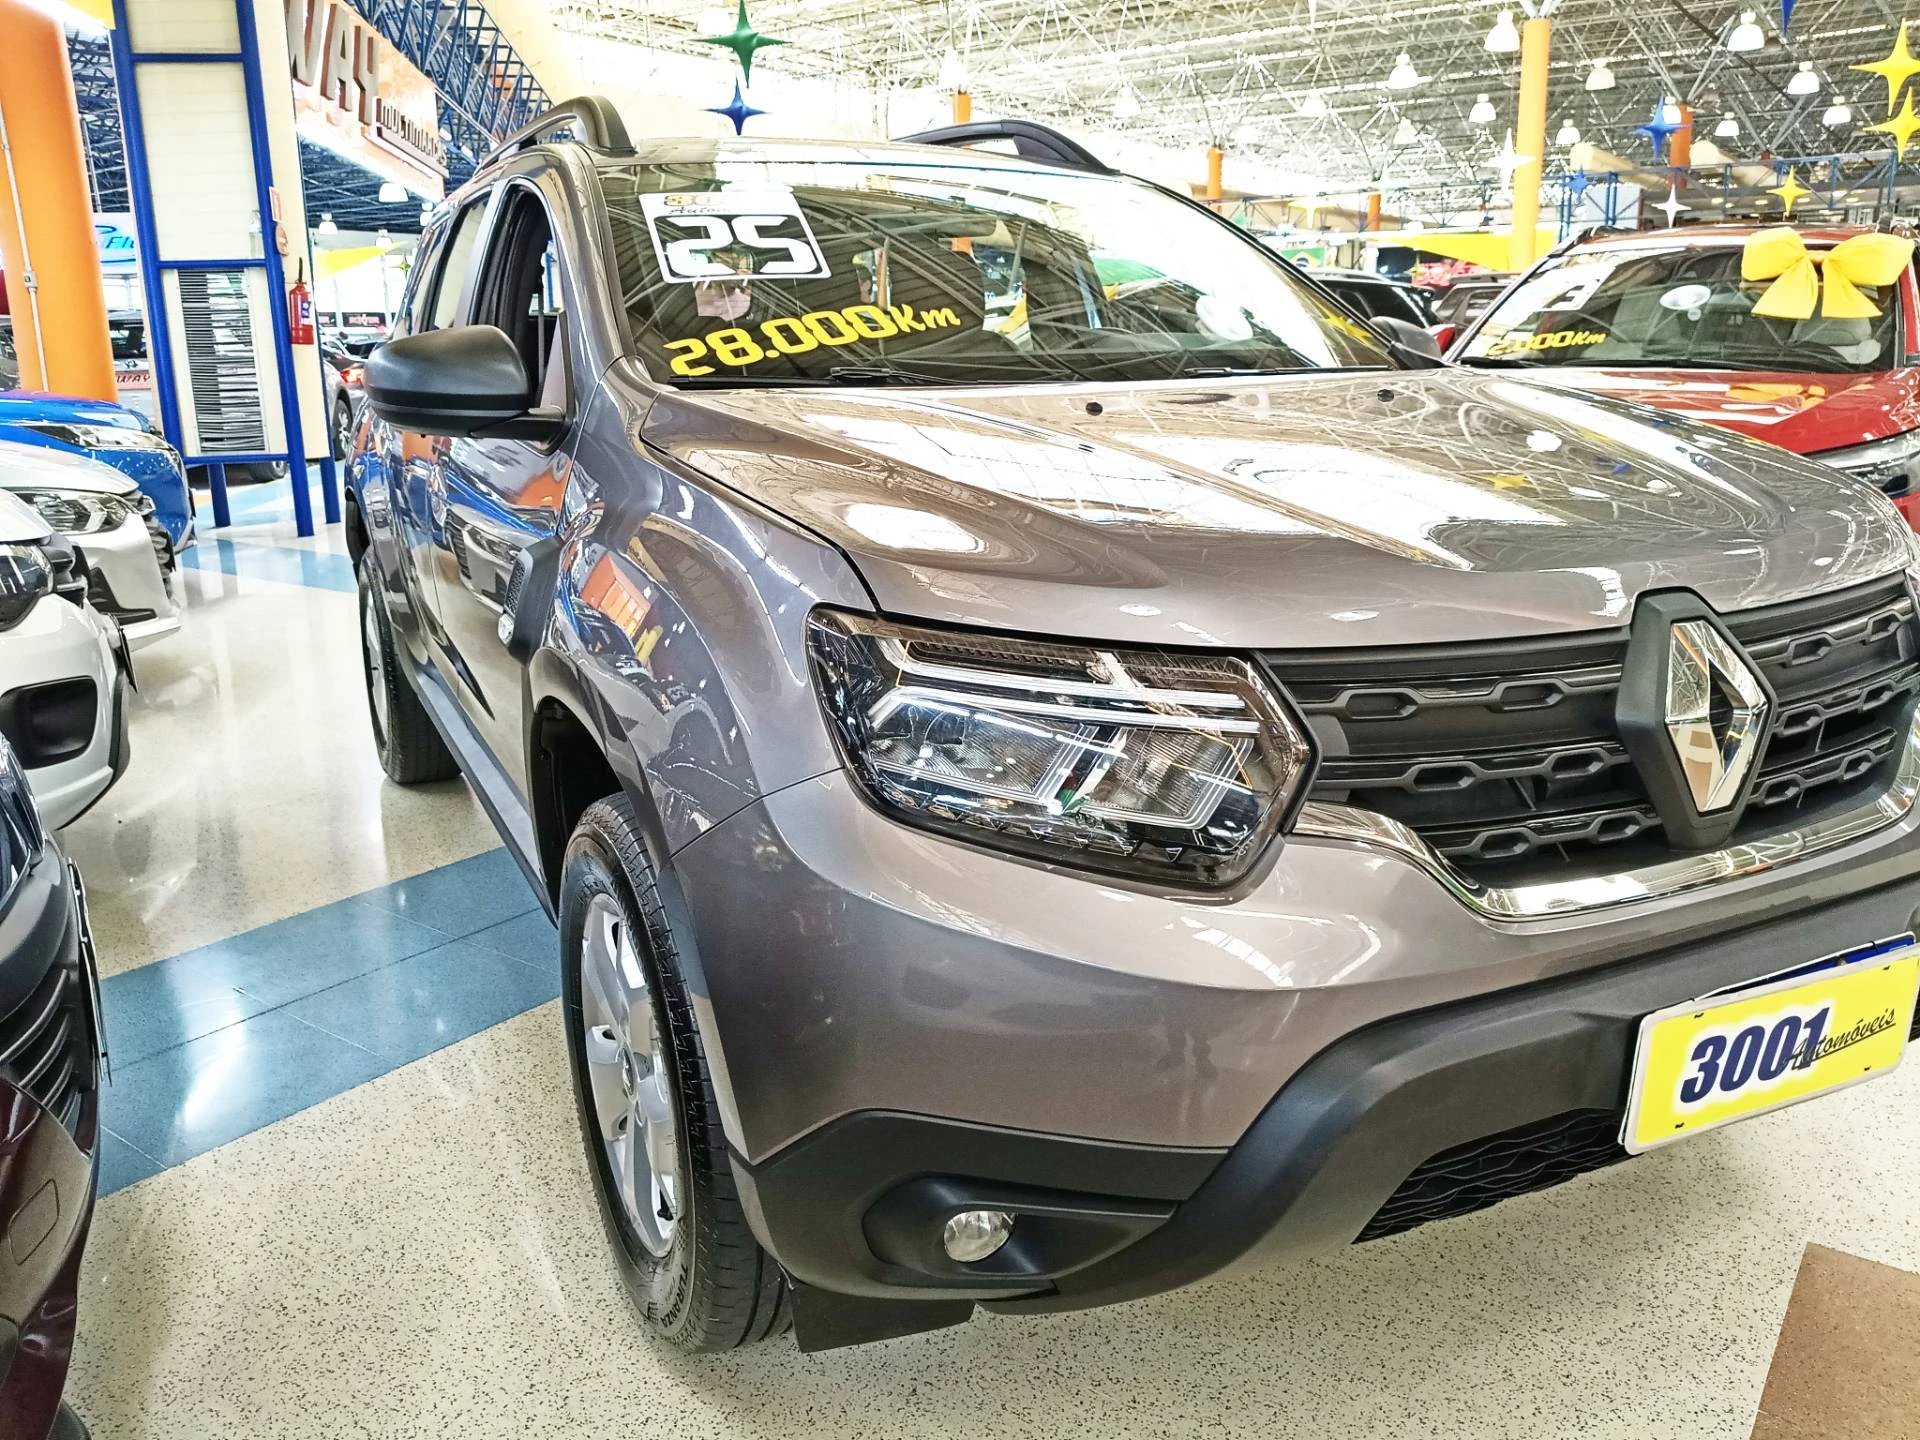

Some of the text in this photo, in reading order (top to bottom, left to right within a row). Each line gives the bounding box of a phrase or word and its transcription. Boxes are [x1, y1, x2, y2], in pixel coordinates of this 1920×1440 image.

[664, 215, 818, 277] 25
[1679, 1006, 1896, 1104] 3001 Automóveis
